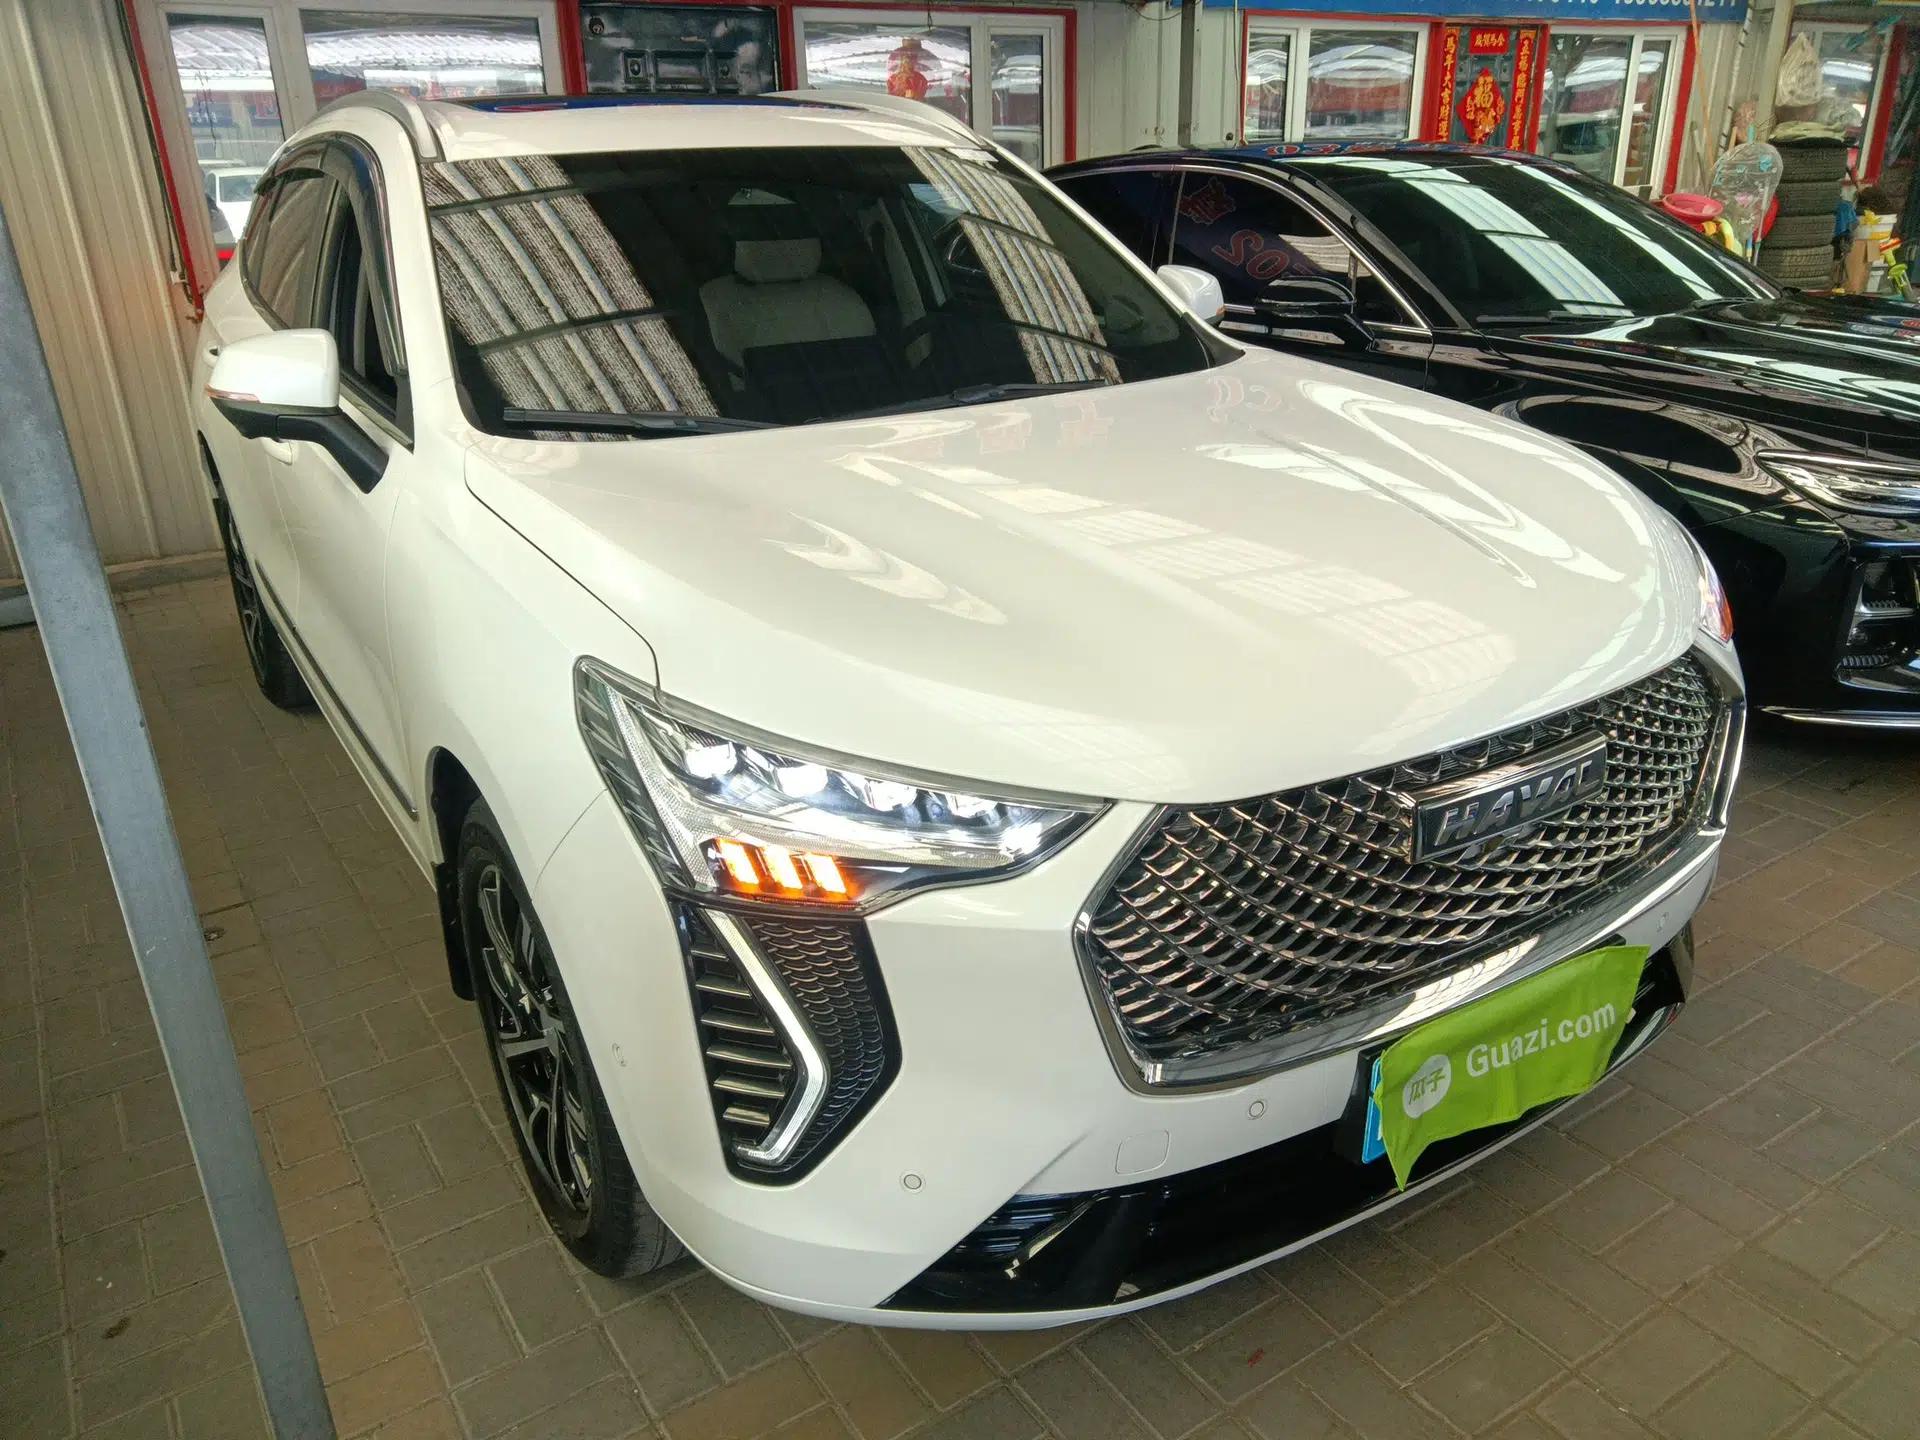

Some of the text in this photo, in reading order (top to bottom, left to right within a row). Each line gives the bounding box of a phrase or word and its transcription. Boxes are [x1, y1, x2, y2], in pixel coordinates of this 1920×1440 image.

[1434, 759, 1600, 847] HAVAL
[1466, 1003, 1616, 1078] Guazi.com
[1408, 1067, 1446, 1105] 瓜子
